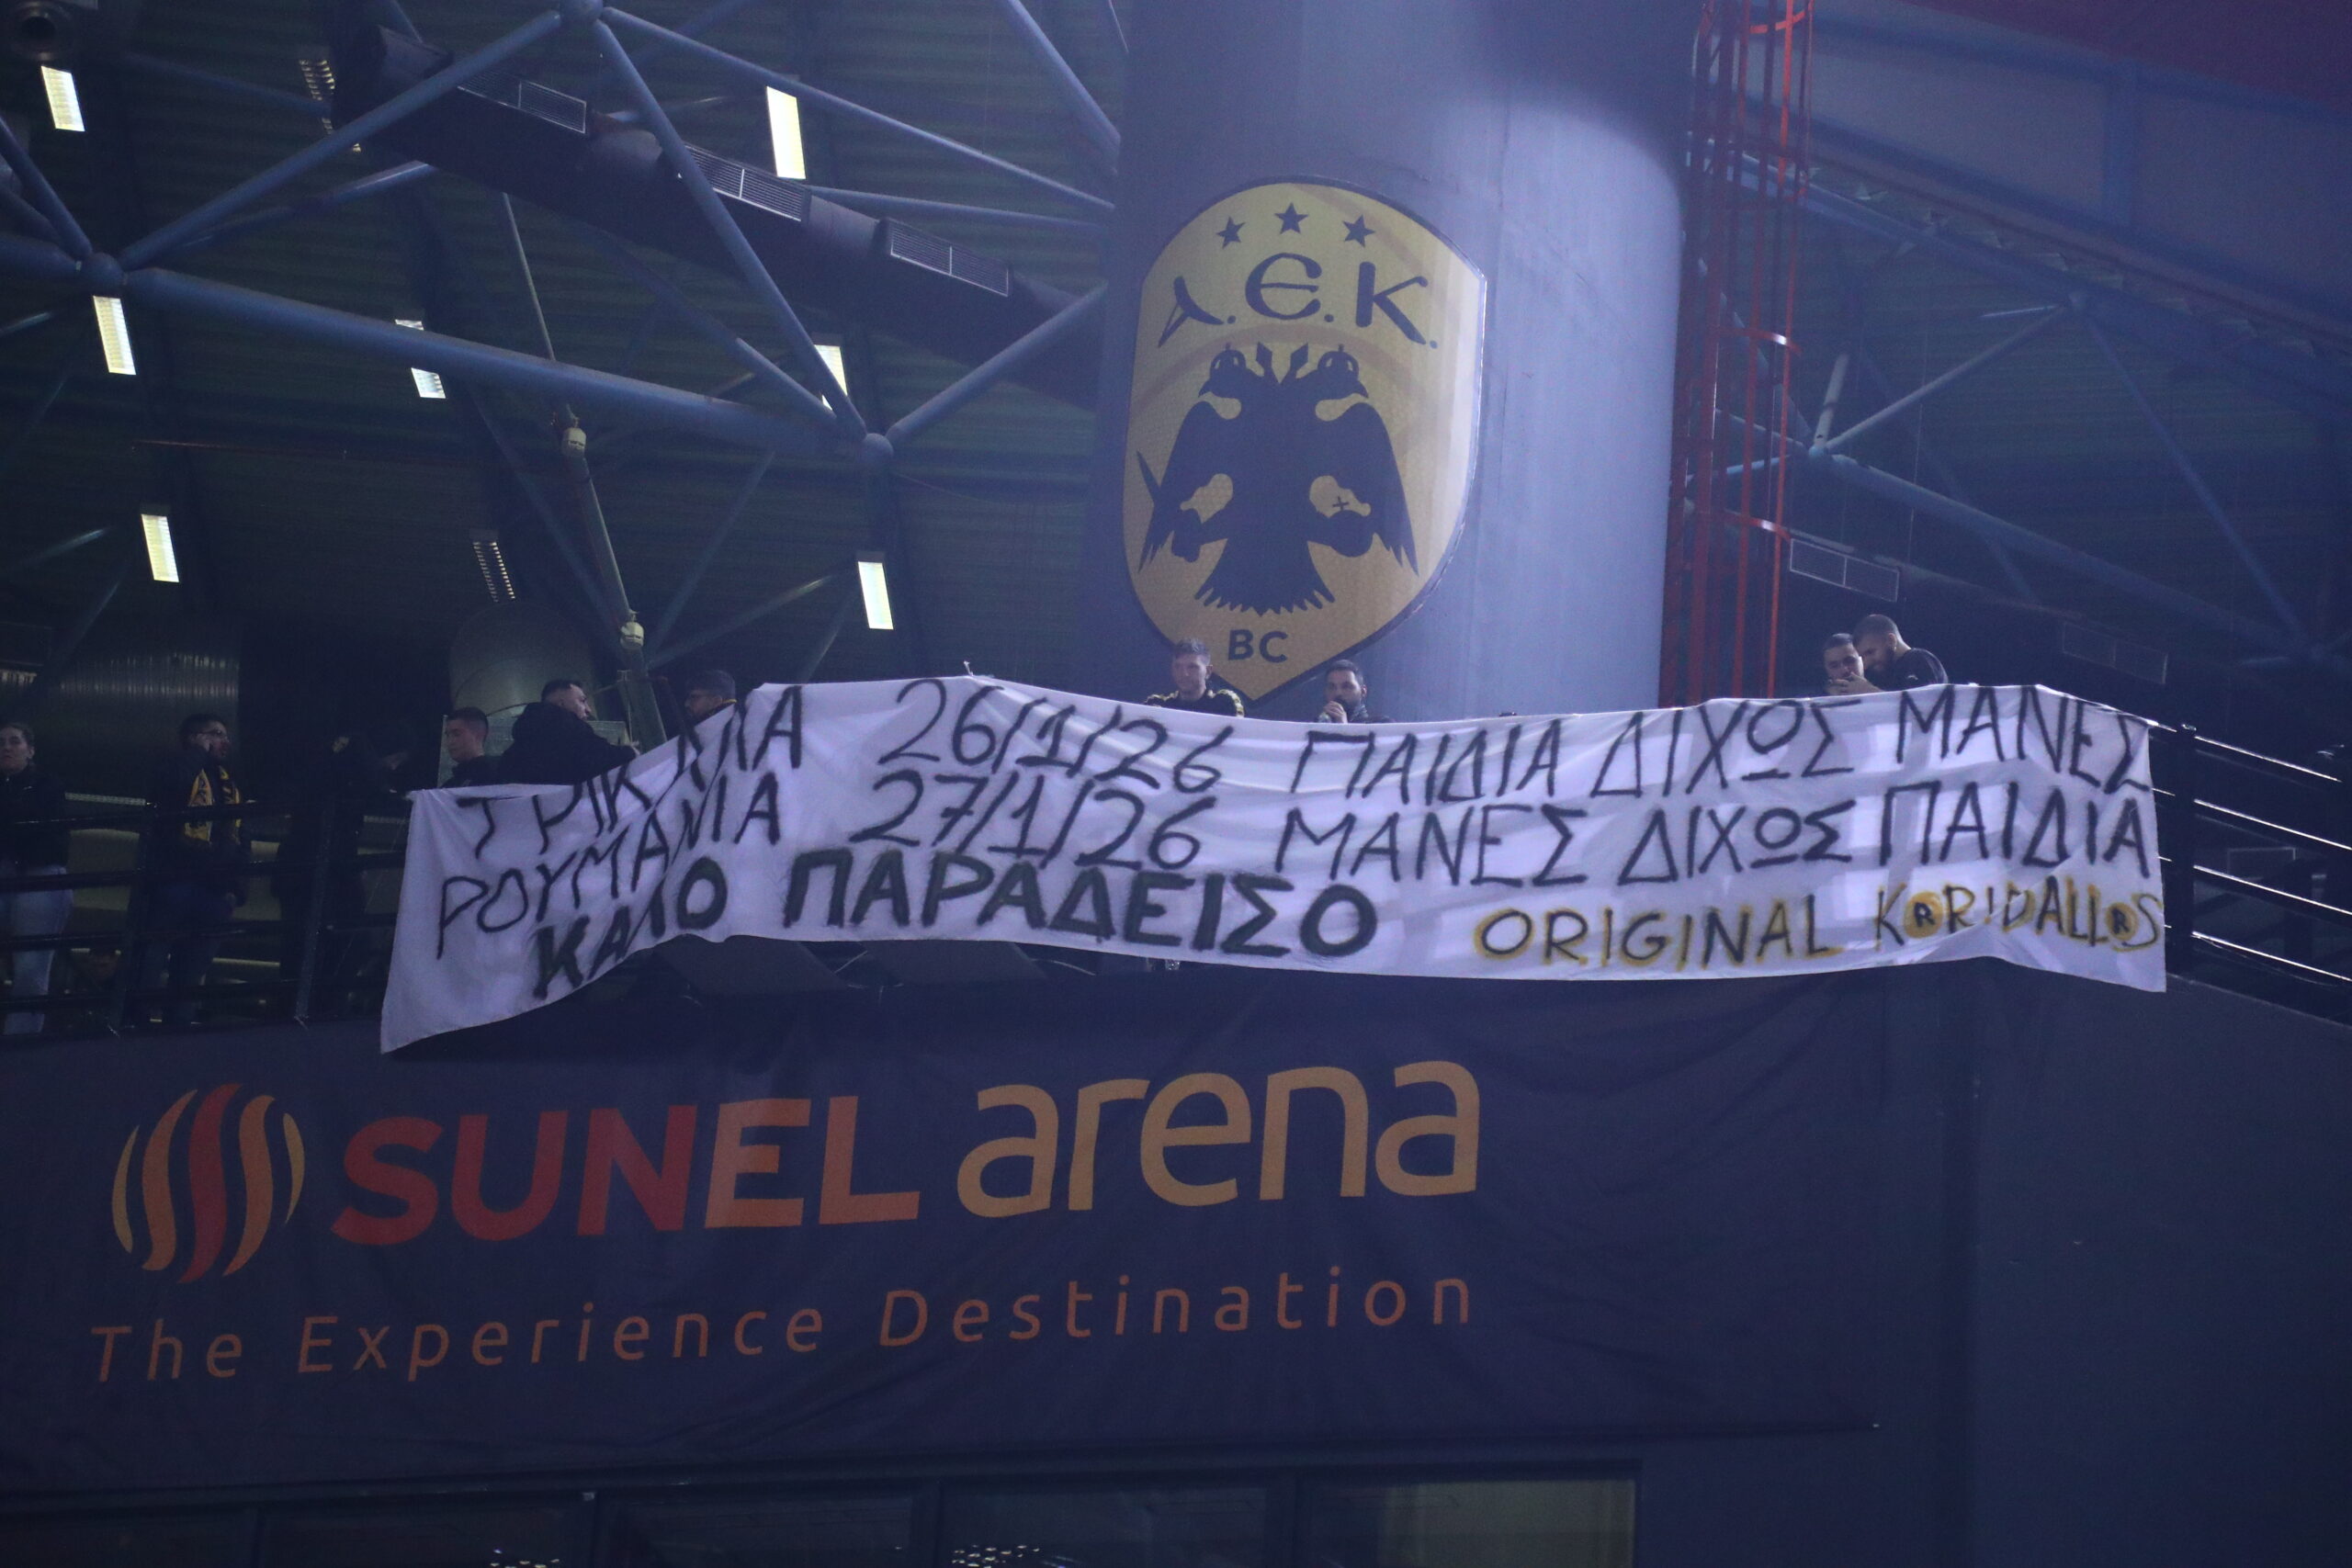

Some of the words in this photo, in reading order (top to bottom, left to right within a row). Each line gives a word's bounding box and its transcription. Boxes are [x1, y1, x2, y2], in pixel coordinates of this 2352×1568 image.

[1227, 628, 1288, 664] BC
[878, 678, 1235, 793] 26/1/26
[1291, 719, 1562, 807] ΠΑΙΔΙΑ
[1589, 698, 1863, 798] ΔΙΧΩΣ
[1895, 683, 2151, 795] ΜΑΝΕΣ
[848, 769, 1217, 869] 27/1/26
[1274, 805, 1589, 887] ΜΑΝΕΣ
[1617, 799, 1858, 887] ΔΙΧΩΣ
[1879, 780, 2151, 879] ΠΑΙΔΙΑ
[531, 856, 729, 999] ΚΑΛΟ
[783, 847, 1379, 958] ΠΑΡΑΔΕΙΣΟ
[1474, 893, 1843, 970] ORIGINAL
[331, 1096, 920, 1245] SUNEL
[956, 1060, 1481, 1218] arena
[90, 1318, 243, 1382] The
[298, 1302, 824, 1382] Experience
[878, 1265, 1470, 1347] Destination
